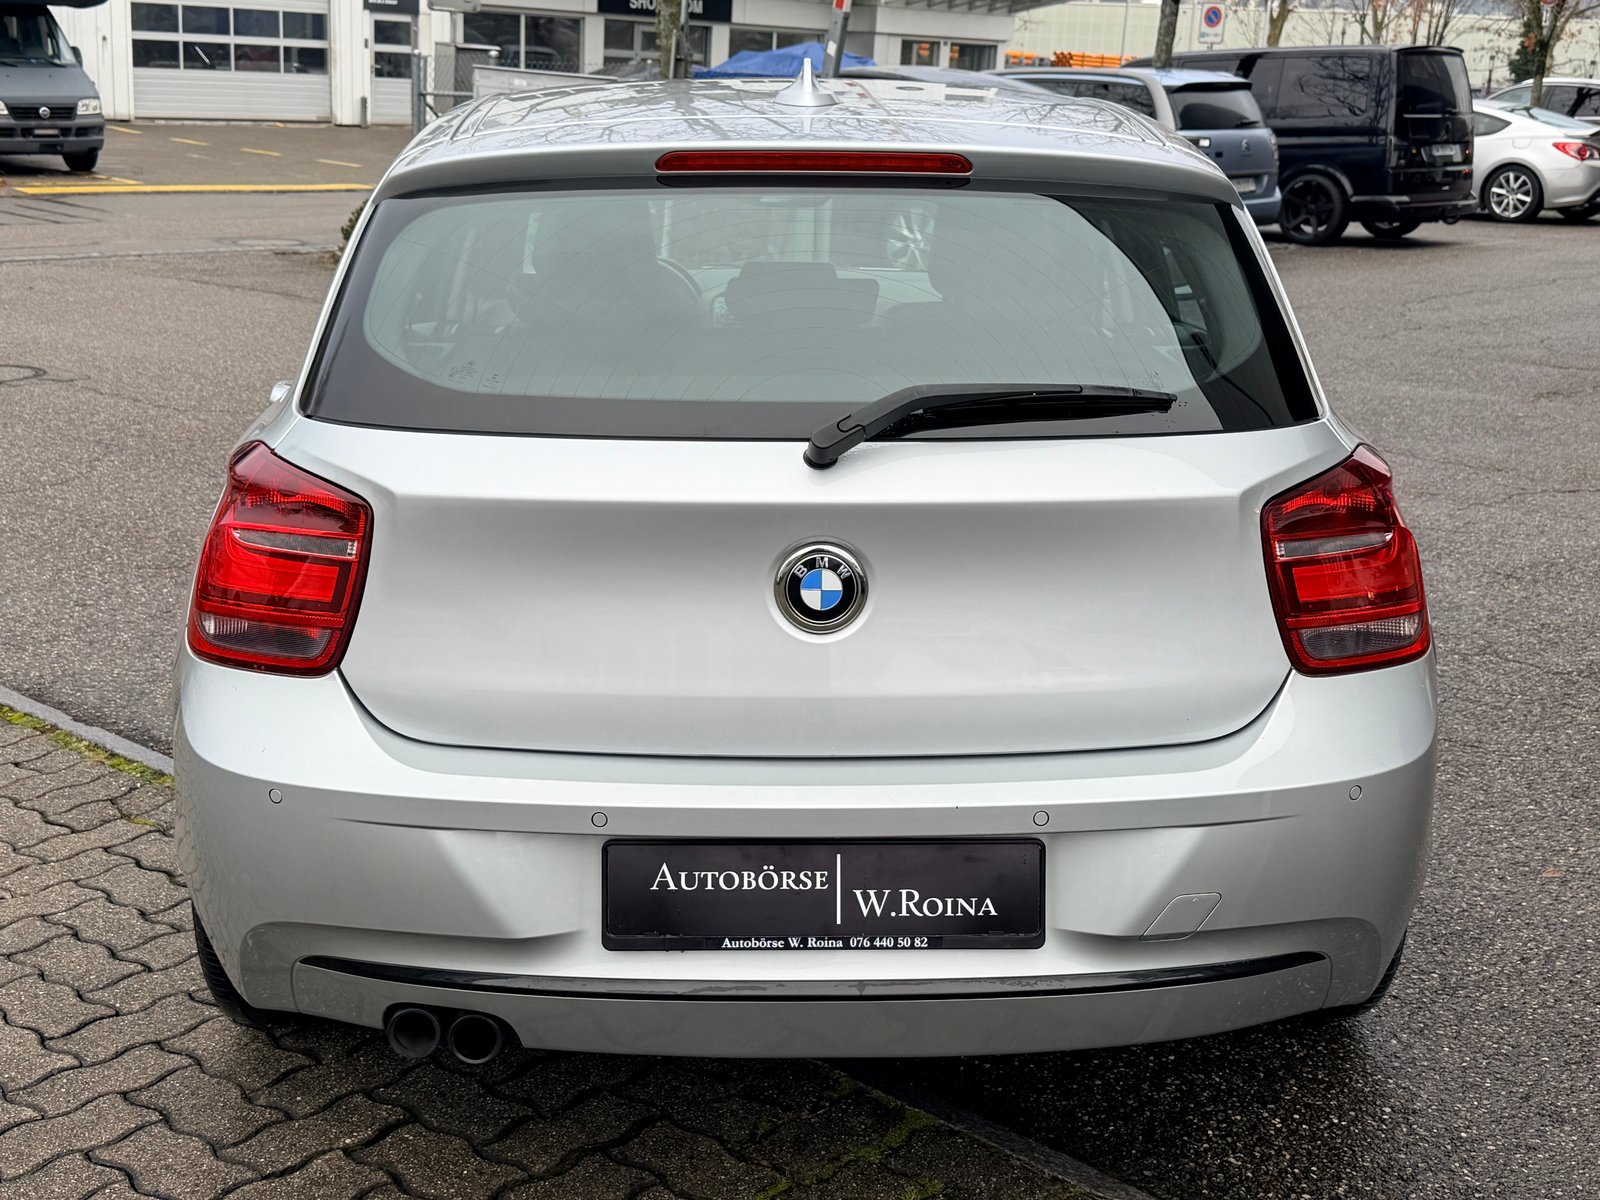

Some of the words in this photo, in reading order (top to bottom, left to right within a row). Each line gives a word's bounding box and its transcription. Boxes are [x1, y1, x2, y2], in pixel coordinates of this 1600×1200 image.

[793, 556, 851, 580] BMW
[649, 862, 829, 891] AUTOBÖRSE
[721, 937, 785, 949] Autobörse
[788, 937, 804, 949] W.
[807, 937, 843, 949] Roina
[849, 937, 871, 948] 076
[873, 937, 893, 948] 440
[897, 937, 911, 948] 50
[914, 937, 929, 948] 82
